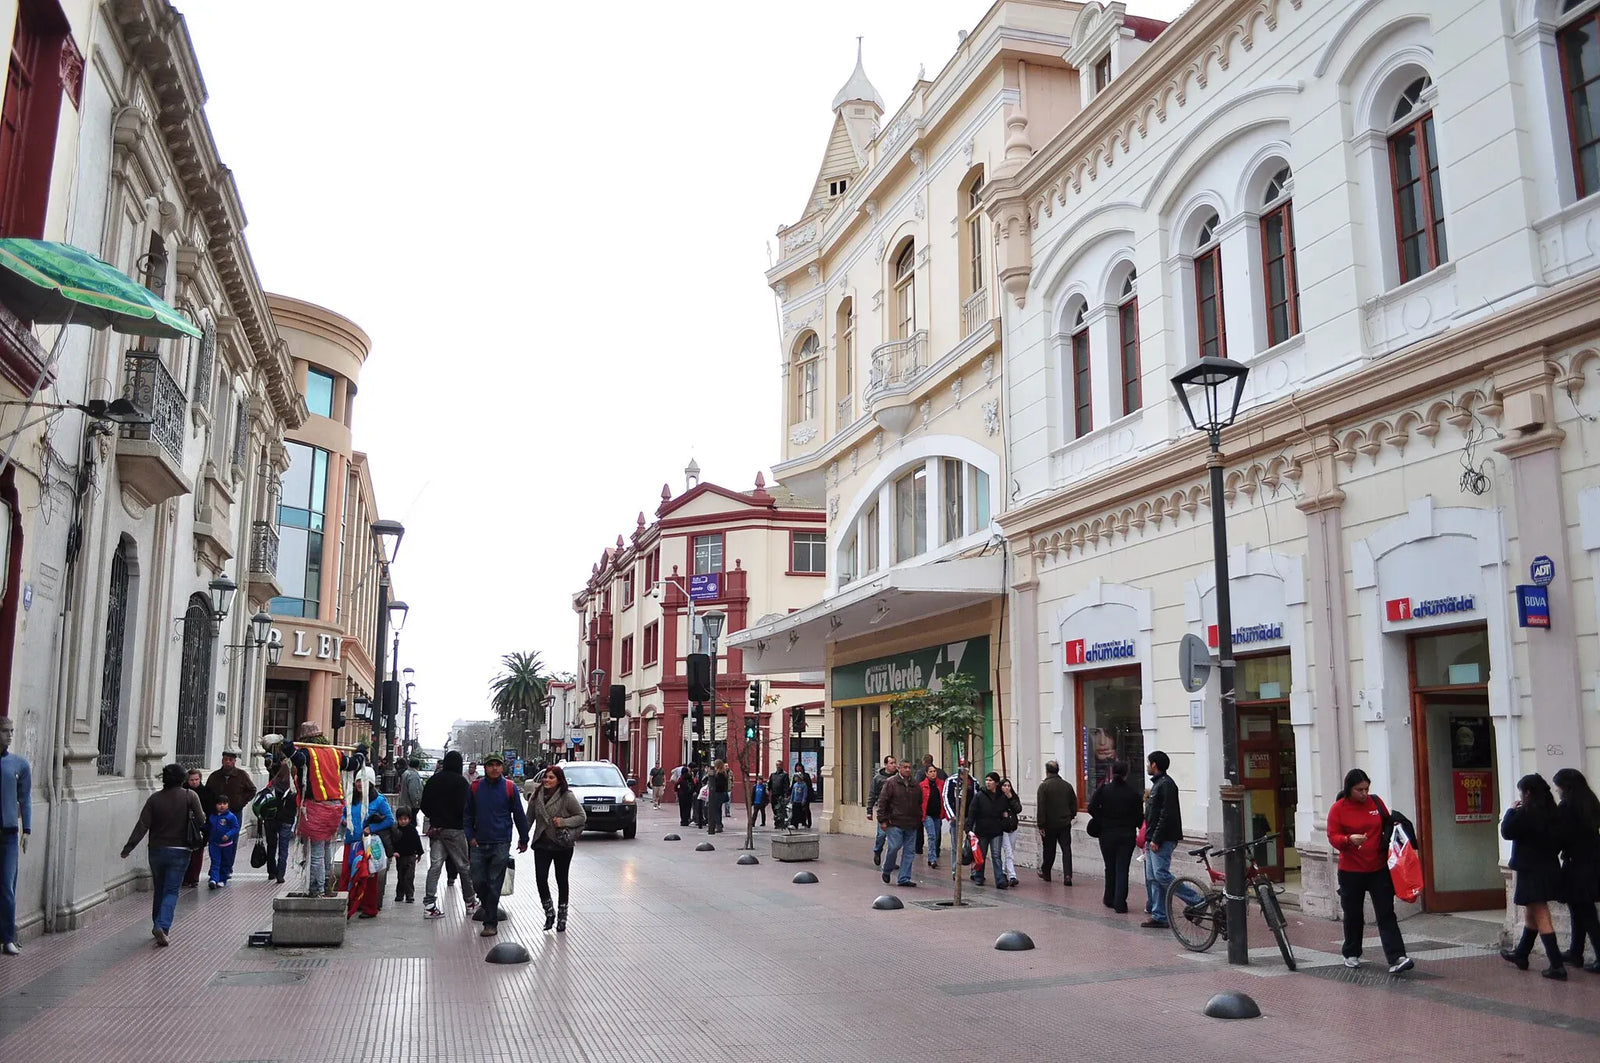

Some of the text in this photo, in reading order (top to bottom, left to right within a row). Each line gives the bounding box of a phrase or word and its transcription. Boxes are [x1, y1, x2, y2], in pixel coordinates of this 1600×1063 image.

[1534, 564, 1551, 578] ADT
[1413, 595, 1474, 618] ahumada
[1525, 596, 1547, 607] BBVA
[1232, 623, 1282, 645] ahumada
[1086, 639, 1135, 662] ahumada
[865, 659, 922, 694] Cruz Verde
